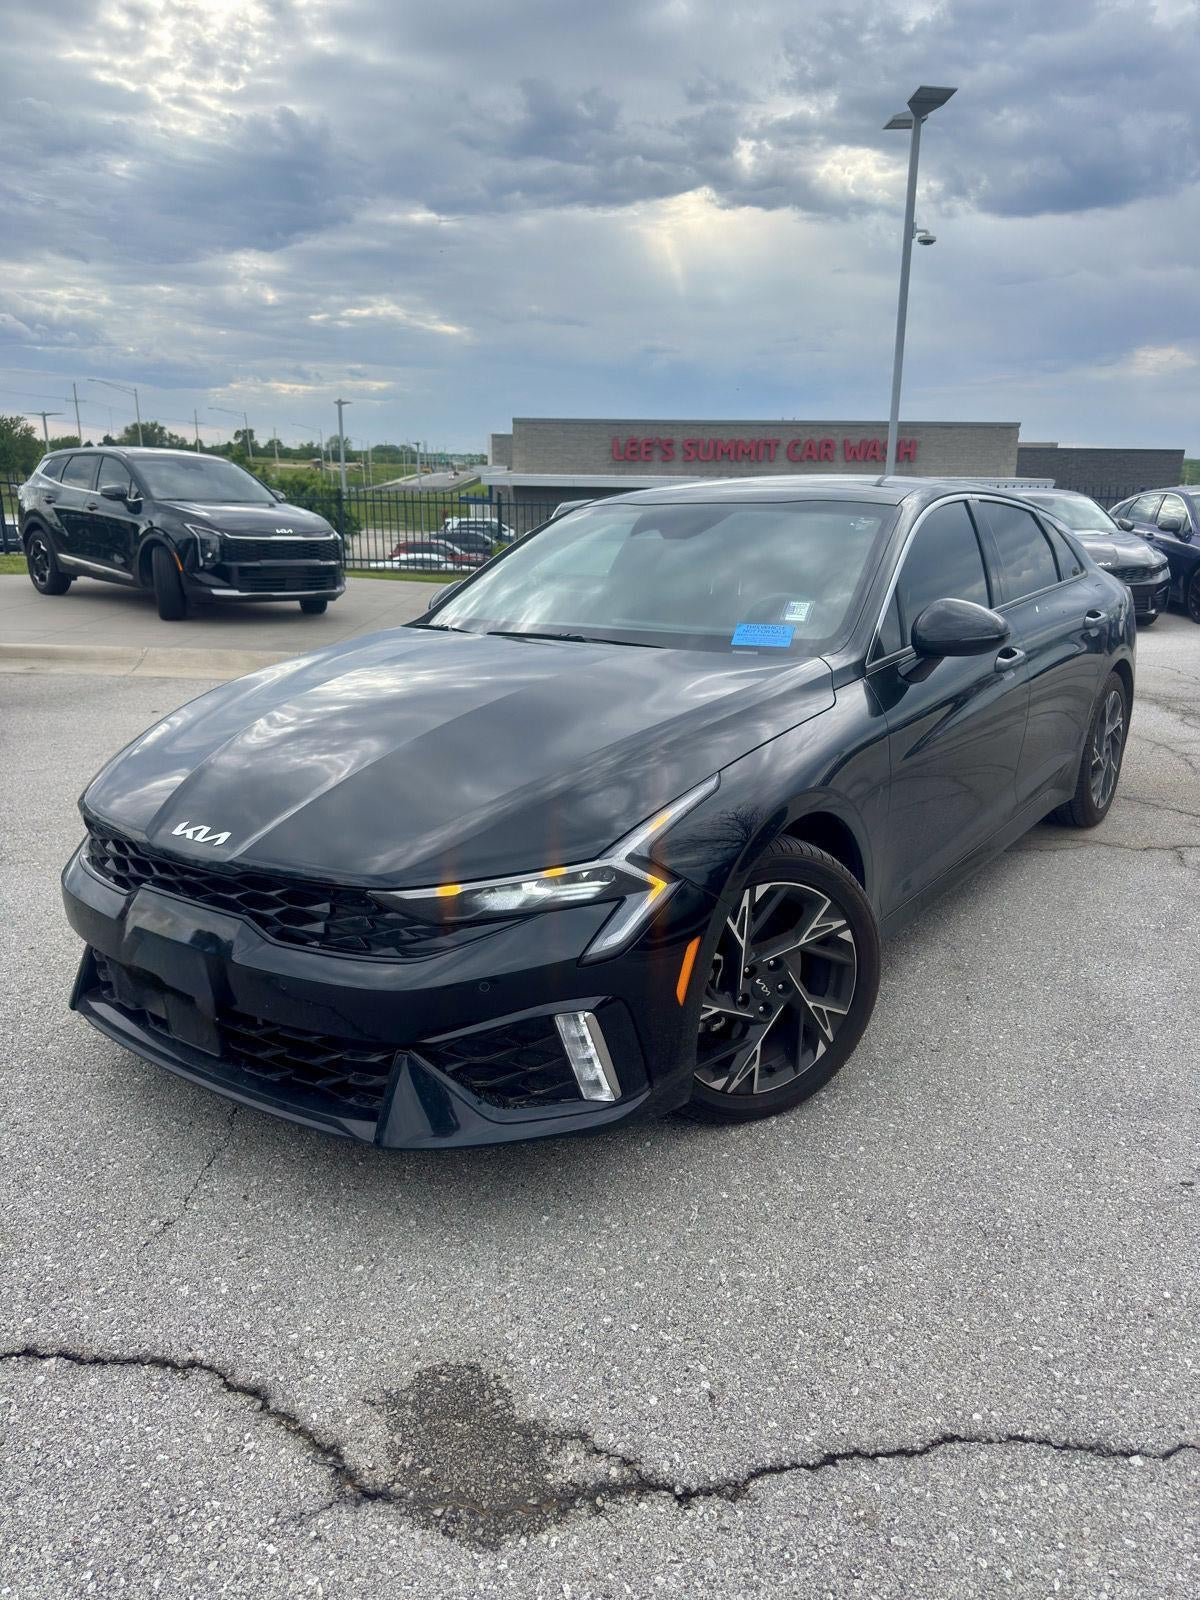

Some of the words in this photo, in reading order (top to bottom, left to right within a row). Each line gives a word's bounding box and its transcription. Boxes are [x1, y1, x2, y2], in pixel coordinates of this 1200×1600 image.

[612, 437, 674, 461] LEE'S
[682, 438, 780, 462] SUMMIT
[786, 438, 835, 462] CAR
[171, 820, 232, 847] KIA
